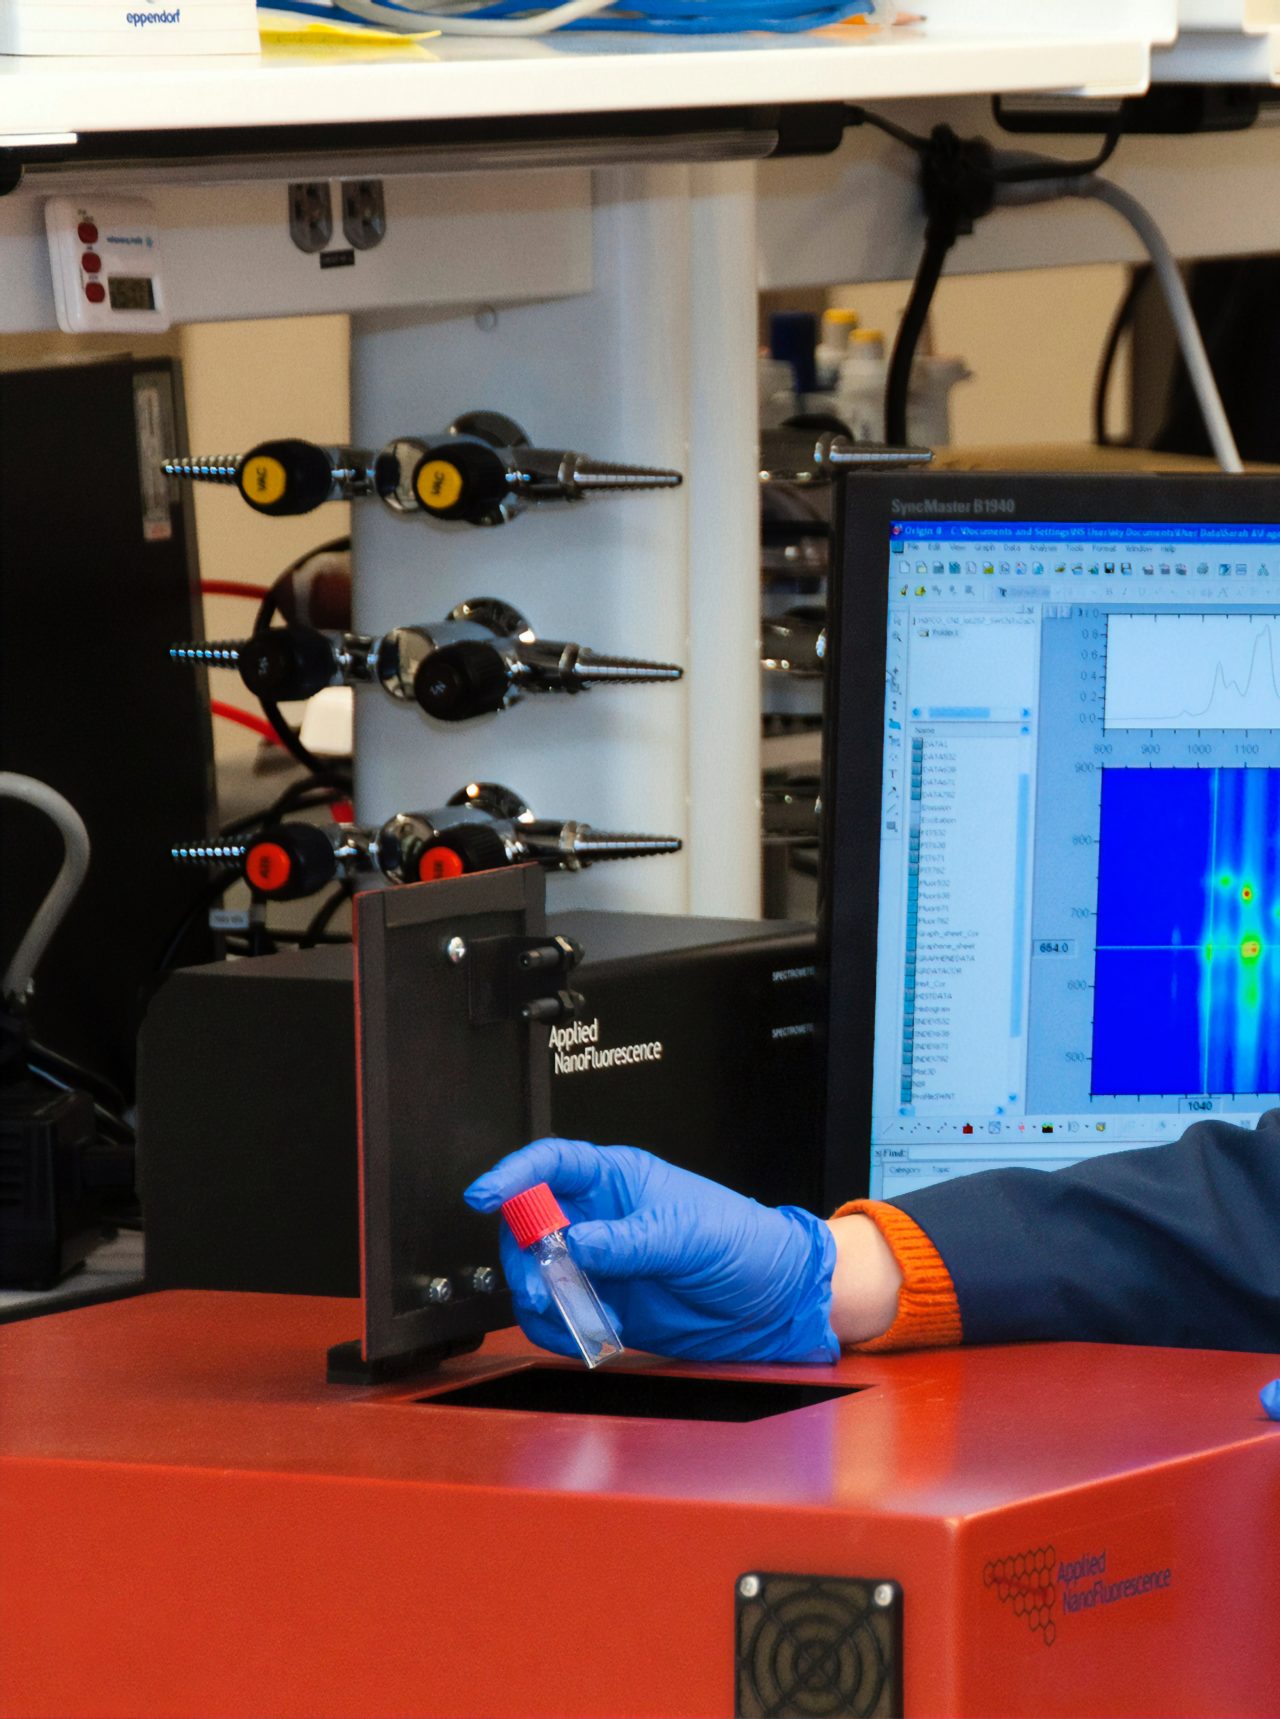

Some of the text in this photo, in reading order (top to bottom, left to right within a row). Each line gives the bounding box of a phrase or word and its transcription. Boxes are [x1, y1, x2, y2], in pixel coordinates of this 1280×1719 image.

[126, 8, 180, 27] eppendorf
[256, 466, 268, 491] VAC
[430, 470, 446, 496] VAC
[891, 499, 1015, 515] SyncMaster B1940
[905, 526, 933, 538] Origin
[1015, 527, 1032, 537] and
[1187, 744, 1212, 754] 1000
[1234, 744, 1260, 754] 1100
[1070, 908, 1090, 918] 700
[1039, 943, 1069, 953] 654.0
[549, 1018, 599, 1050] Applied
[554, 1040, 662, 1074] NanoFluorescence
[1065, 1053, 1085, 1062] 500
[1187, 1101, 1213, 1111] 1040
[882, 1149, 907, 1158] Find:
[889, 1165, 921, 1175] Category
[1057, 1549, 1107, 1588] Applied
[1062, 1568, 1172, 1615] NanoFluorescence
